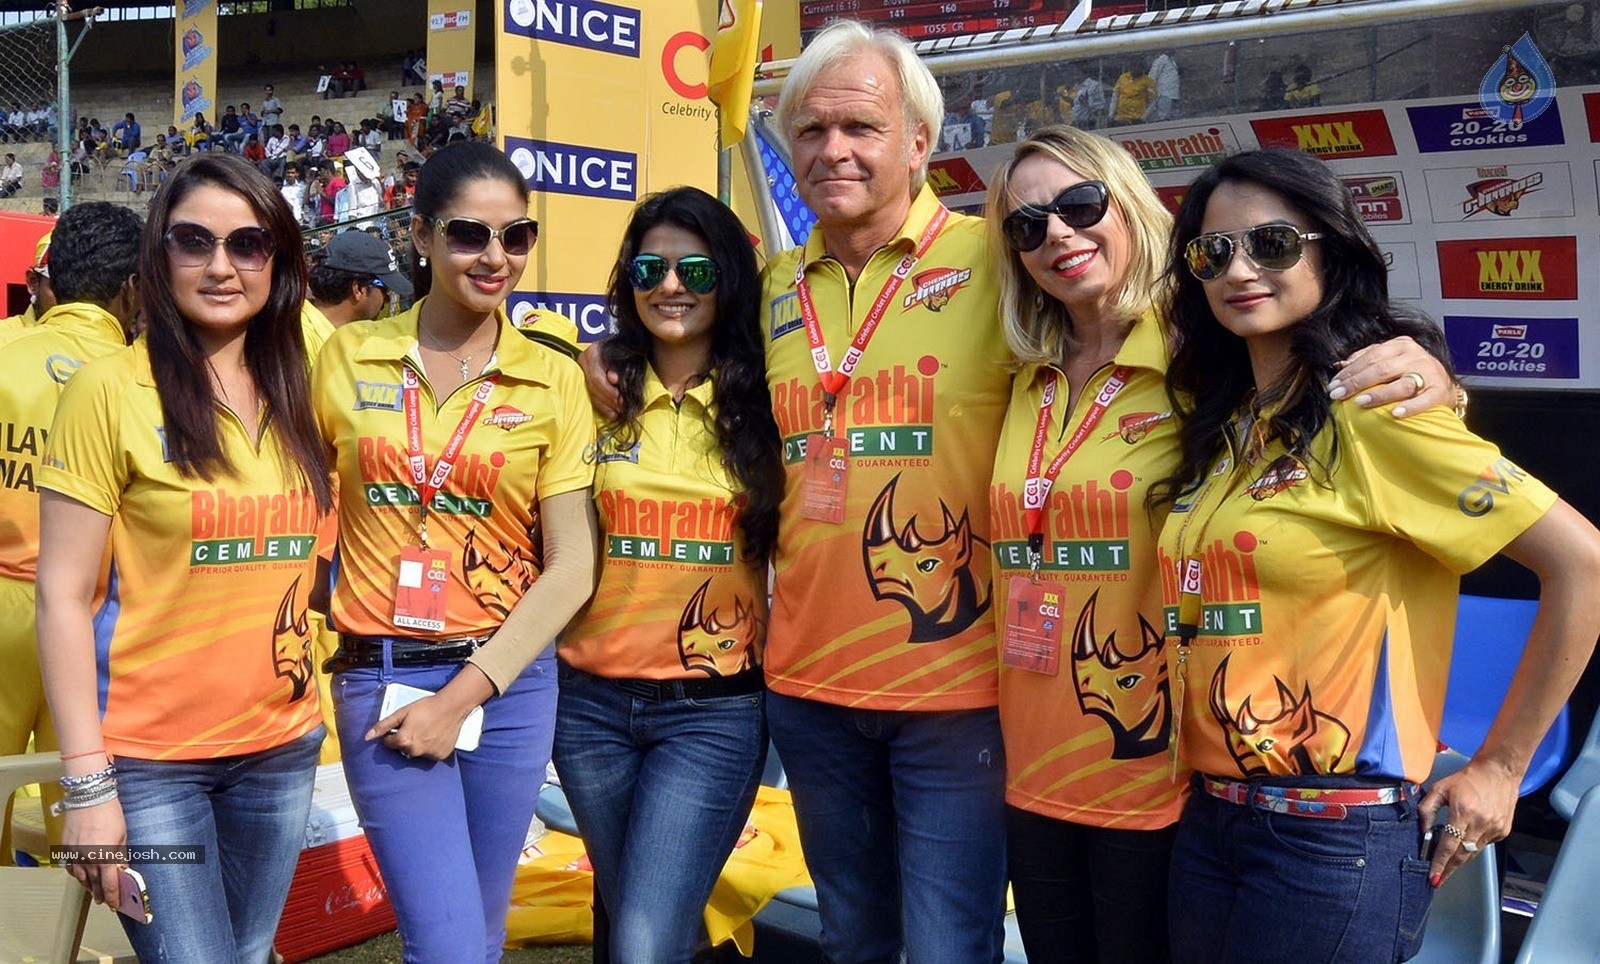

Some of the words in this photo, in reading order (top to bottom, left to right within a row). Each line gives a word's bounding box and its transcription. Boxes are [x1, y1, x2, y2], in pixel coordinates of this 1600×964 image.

[803, 4, 834, 14] Current
[889, 9, 905, 18] 141
[940, 4, 957, 14] 160
[536, 0, 636, 49] NICE
[923, 24, 947, 34] TOSS
[952, 22, 965, 31] CR
[396, 105, 403, 118] 4
[662, 102, 712, 121] Celebrity
[1291, 121, 1362, 148] XXX
[1450, 120, 1523, 136] 20-20
[1335, 143, 1362, 153] DRINK
[1450, 133, 1528, 146] cookies
[535, 150, 633, 193] NICE
[1362, 213, 1388, 221] obiles
[1477, 250, 1544, 282] XXX
[922, 269, 957, 288] CHENNAI
[1481, 282, 1512, 291] ENERGY
[1514, 282, 1543, 291] DRINK
[856, 318, 876, 345] Celebrity
[871, 298, 887, 319] Cricket
[881, 278, 899, 299] League
[1477, 341, 1545, 358] 20-20
[842, 351, 861, 373] CCL
[1476, 359, 1547, 372] cookies
[1099, 378, 1122, 403] CCL
[1039, 408, 1048, 428] League
[445, 434, 463, 459] Celebrity
[785, 431, 927, 460] CEENT
[1034, 427, 1044, 448] Cricket
[1048, 448, 1071, 475] Celebrity
[1068, 427, 1085, 449] Cricket
[1083, 405, 1100, 430] League
[414, 457, 424, 481] CCL
[1030, 446, 1040, 475] Celebrity
[432, 464, 450, 486] CCL
[1026, 479, 1039, 506] CCL
[194, 540, 313, 561] CEMEN
[189, 565, 233, 575] SUPERIOR
[427, 570, 447, 581] CCL
[1187, 562, 1200, 592] CCL
[1039, 604, 1060, 618] CCL
[397, 617, 411, 626] ALL
[412, 618, 442, 629] ACCESS
